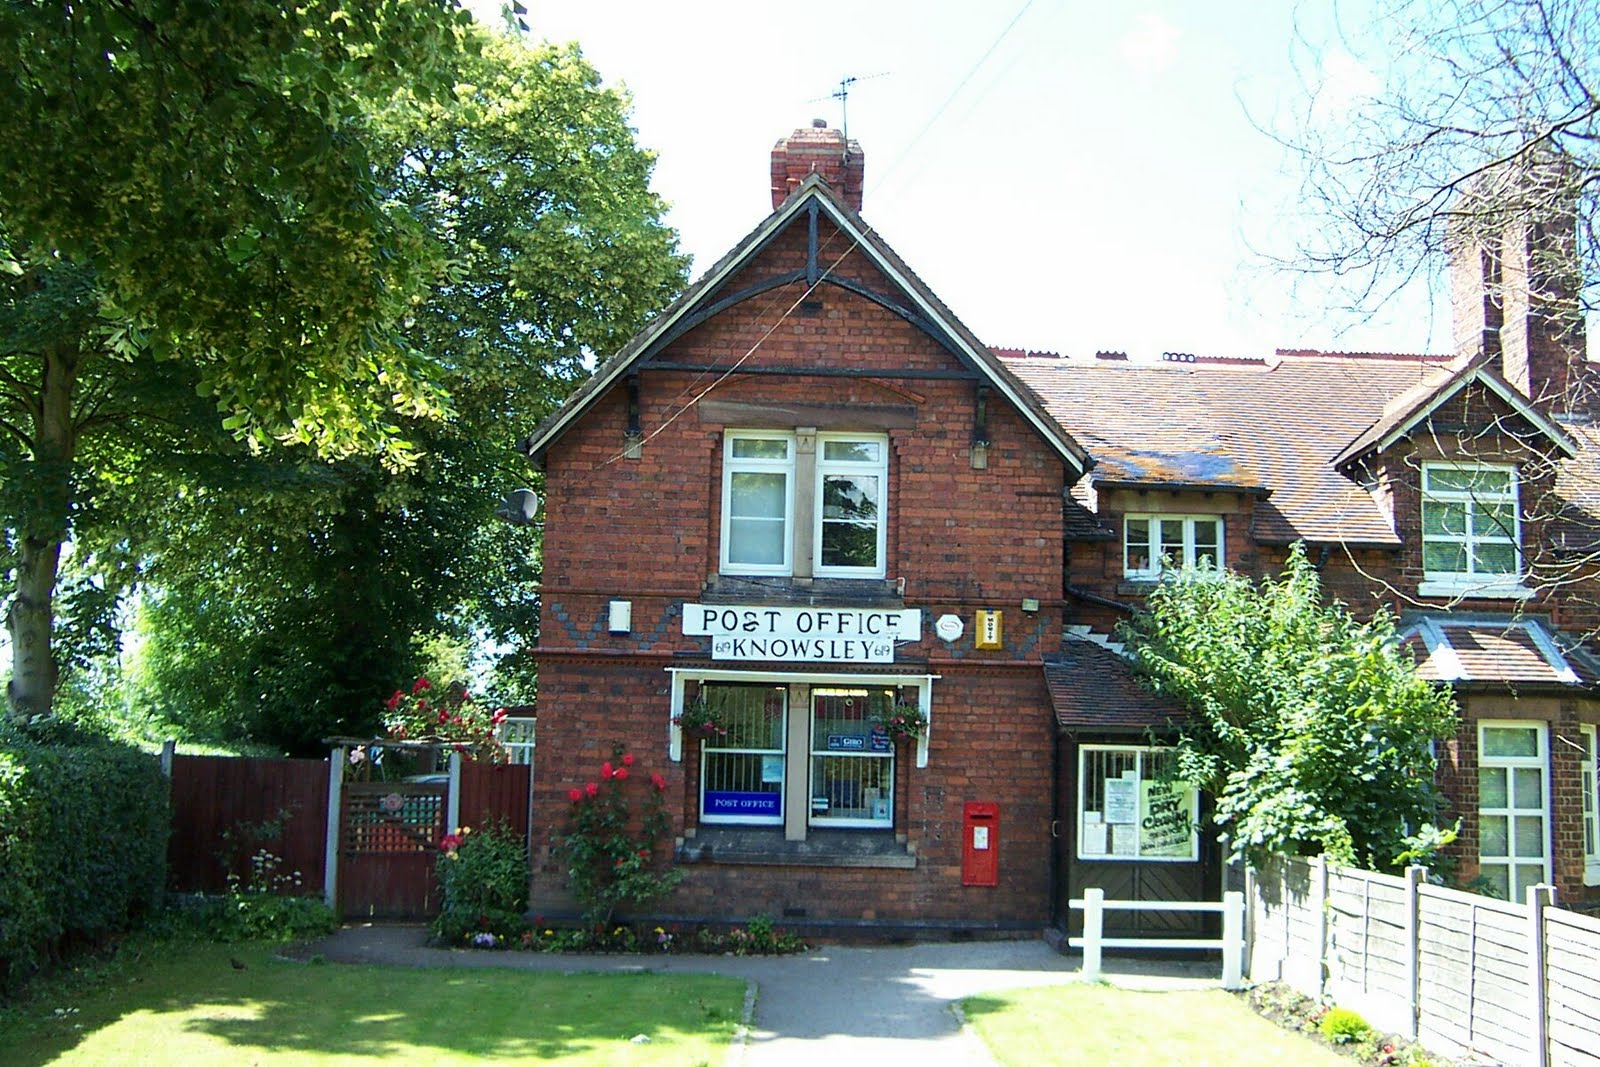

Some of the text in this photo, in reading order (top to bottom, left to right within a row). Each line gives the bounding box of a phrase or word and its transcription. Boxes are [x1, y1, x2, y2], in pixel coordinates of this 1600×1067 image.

[702, 609, 902, 635] POST OFFICE
[733, 638, 874, 660] KNOWSLEY
[1148, 783, 1173, 796] NEW
[714, 799, 775, 809] POST OFFICE
